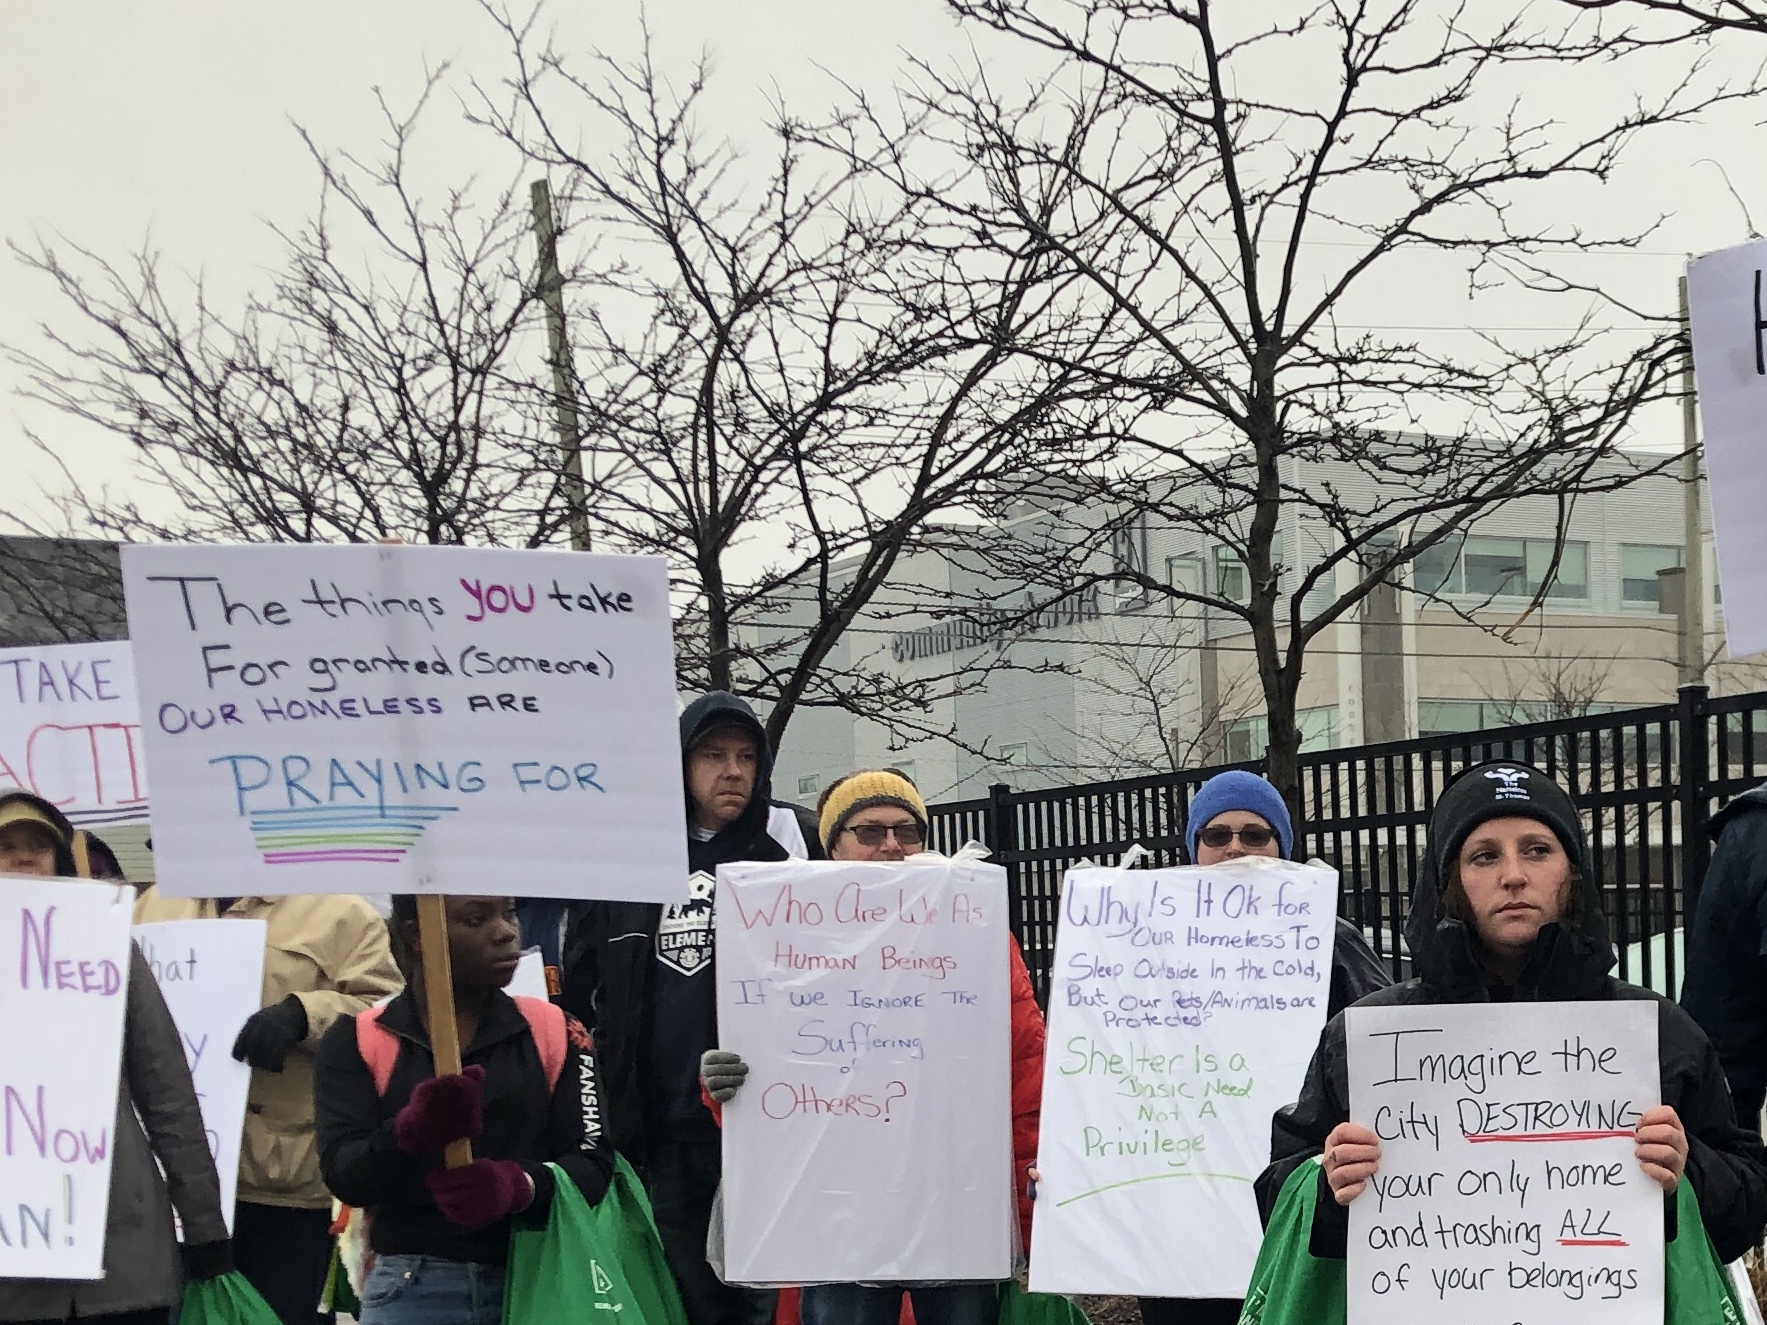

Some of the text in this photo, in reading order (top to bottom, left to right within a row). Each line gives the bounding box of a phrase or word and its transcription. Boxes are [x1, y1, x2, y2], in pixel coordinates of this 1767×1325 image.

[147, 576, 291, 631] The
[302, 578, 445, 631] things
[548, 581, 635, 615] take
[0, 658, 120, 703] TAKE
[201, 644, 290, 689] For
[159, 696, 540, 734] OUR HOMELESS ARE
[208, 755, 607, 819] PRAYING FOR
[727, 880, 823, 929] Who
[836, 882, 887, 925] Are
[951, 893, 983, 923] As
[1066, 879, 1140, 938] Why
[1148, 880, 1176, 917] Is
[1196, 879, 1214, 918] It
[139, 936, 197, 984] hat
[1187, 927, 1286, 950] Homeless
[1289, 925, 1321, 951] To
[1067, 952, 1124, 982] Sleep
[1211, 958, 1226, 980] In
[1236, 959, 1267, 980] the
[1272, 959, 1322, 983] Cold,
[1067, 986, 1109, 1007] But
[1059, 1036, 1184, 1076] Shelter
[1369, 1028, 1622, 1094] Imagine the
[1198, 1101, 1217, 1118] A
[1204, 1077, 1253, 1098] Need
[1083, 1126, 1206, 1167] Privilege
[1375, 1098, 1640, 1151] City DESTROYING
[1371, 1159, 1627, 1213] your only home
[0, 1174, 74, 1249] N!
[1369, 1208, 1622, 1255] and trashing ALL
[1371, 1261, 1639, 1301] of your belongings
